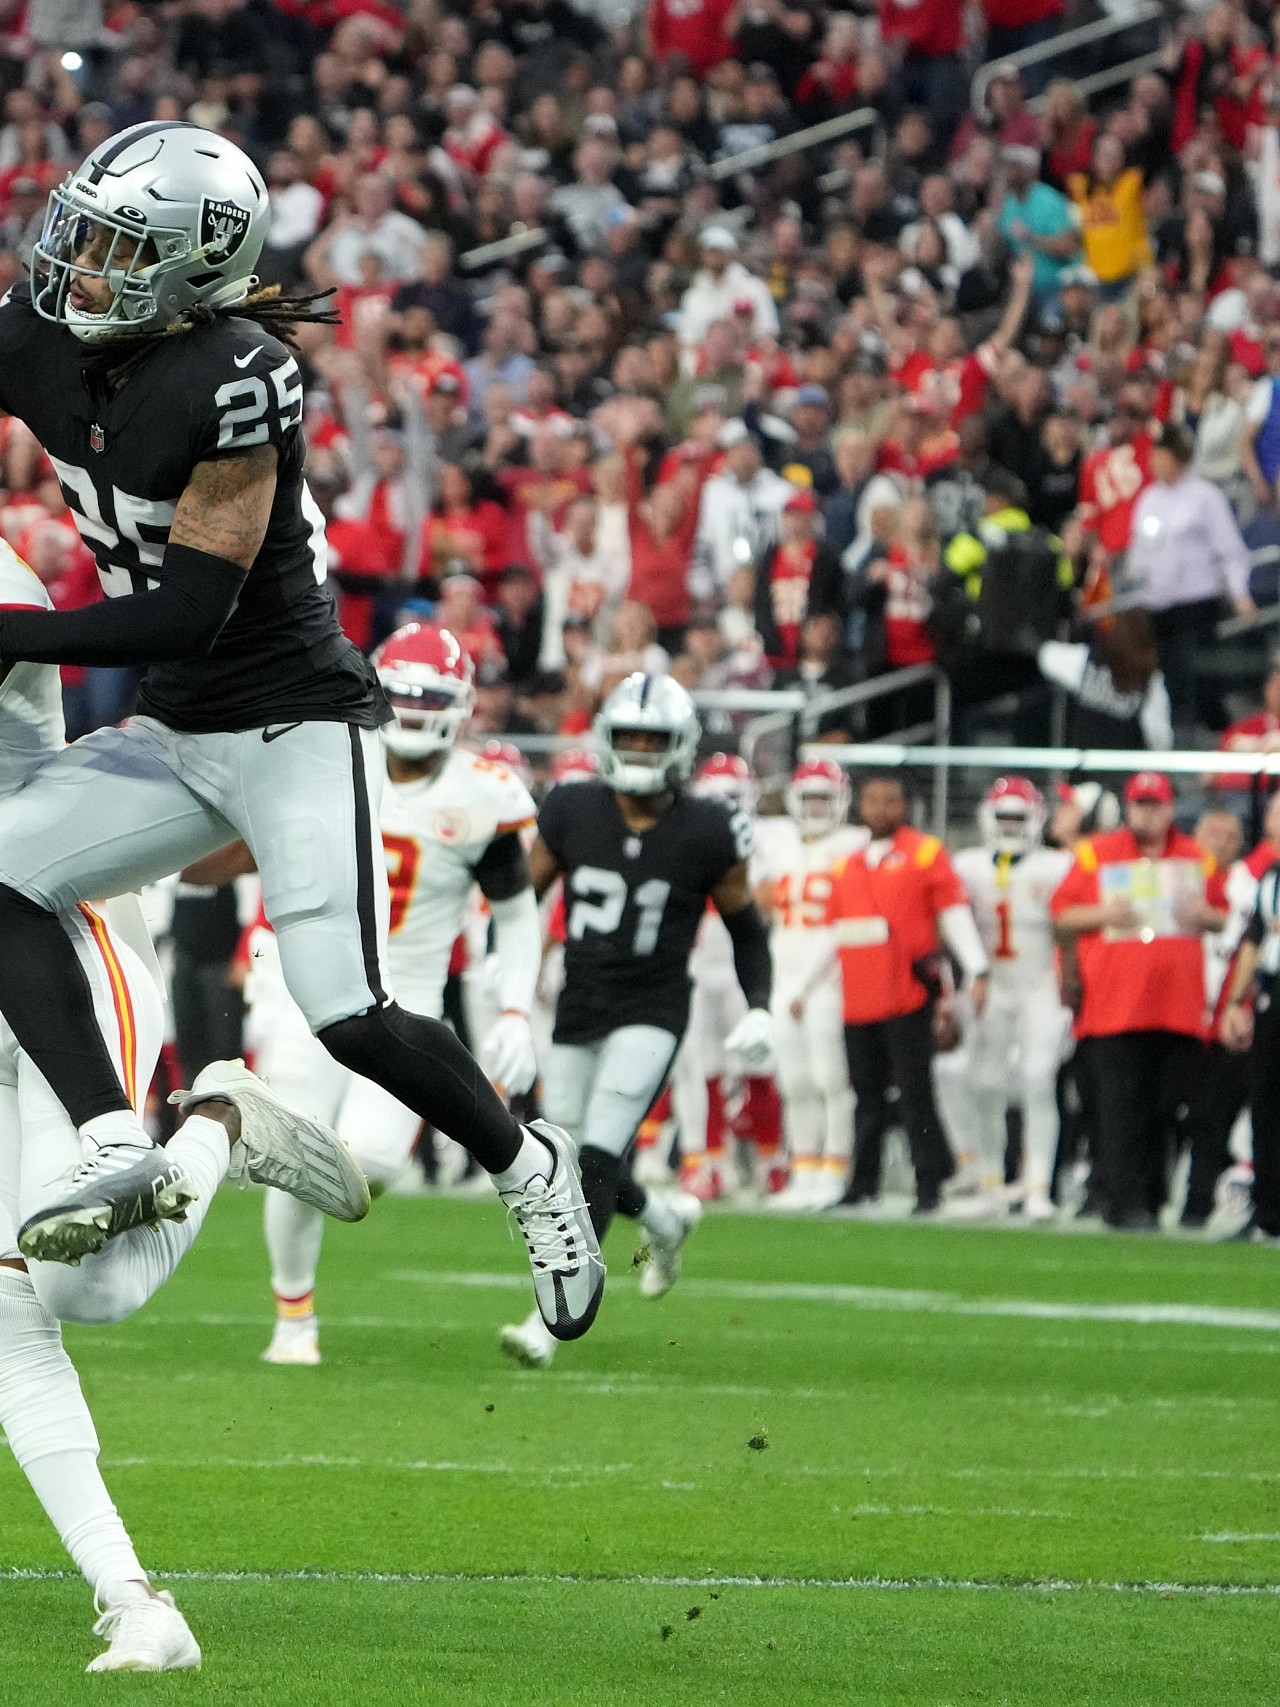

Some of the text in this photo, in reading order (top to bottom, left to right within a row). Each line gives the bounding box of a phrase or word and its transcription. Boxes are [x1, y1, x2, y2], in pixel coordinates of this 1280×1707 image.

[208, 201, 248, 220] RAIDERS
[214, 355, 303, 449] 25
[570, 864, 671, 957] 21
